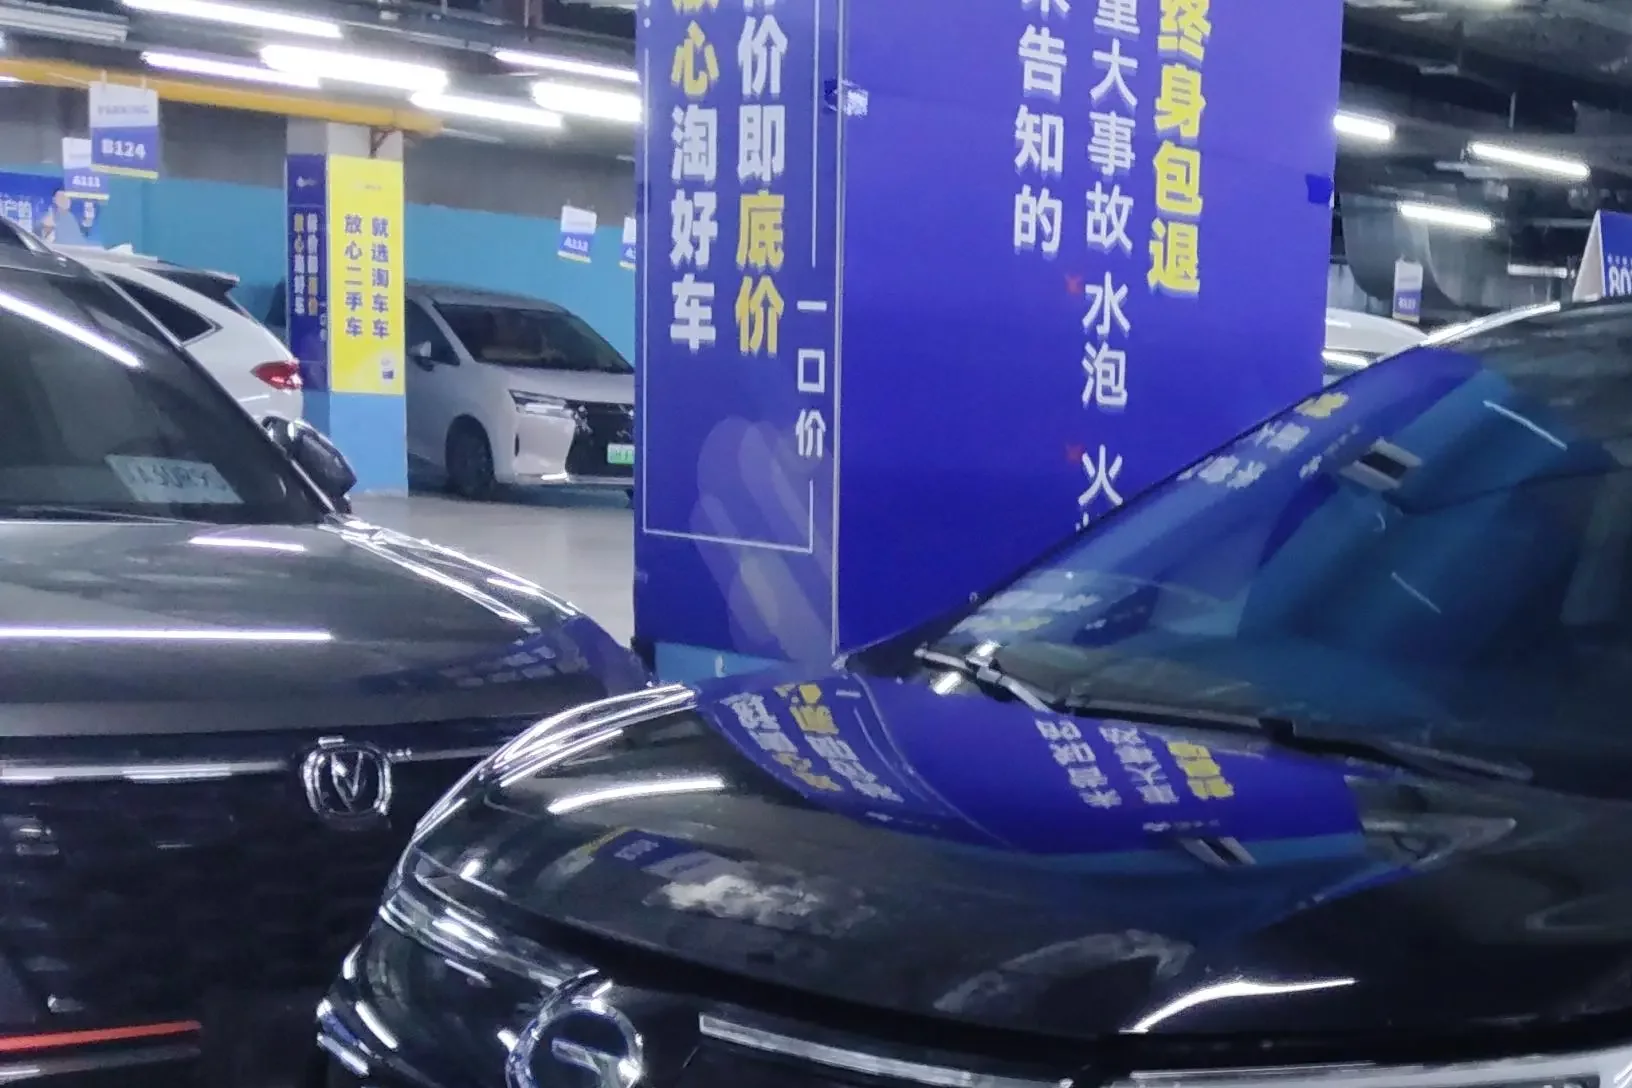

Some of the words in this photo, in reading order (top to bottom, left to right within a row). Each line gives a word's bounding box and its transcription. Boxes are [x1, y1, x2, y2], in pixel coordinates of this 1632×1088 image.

[101, 138, 146, 161] B124
[670, 0, 719, 350] 心淘好车
[735, 0, 788, 356] 价即底价
[1013, 0, 1070, 257] 告知的
[344, 213, 363, 338] 放心二手车
[371, 216, 390, 340] 就选淘车车
[796, 300, 828, 459] 一口价
